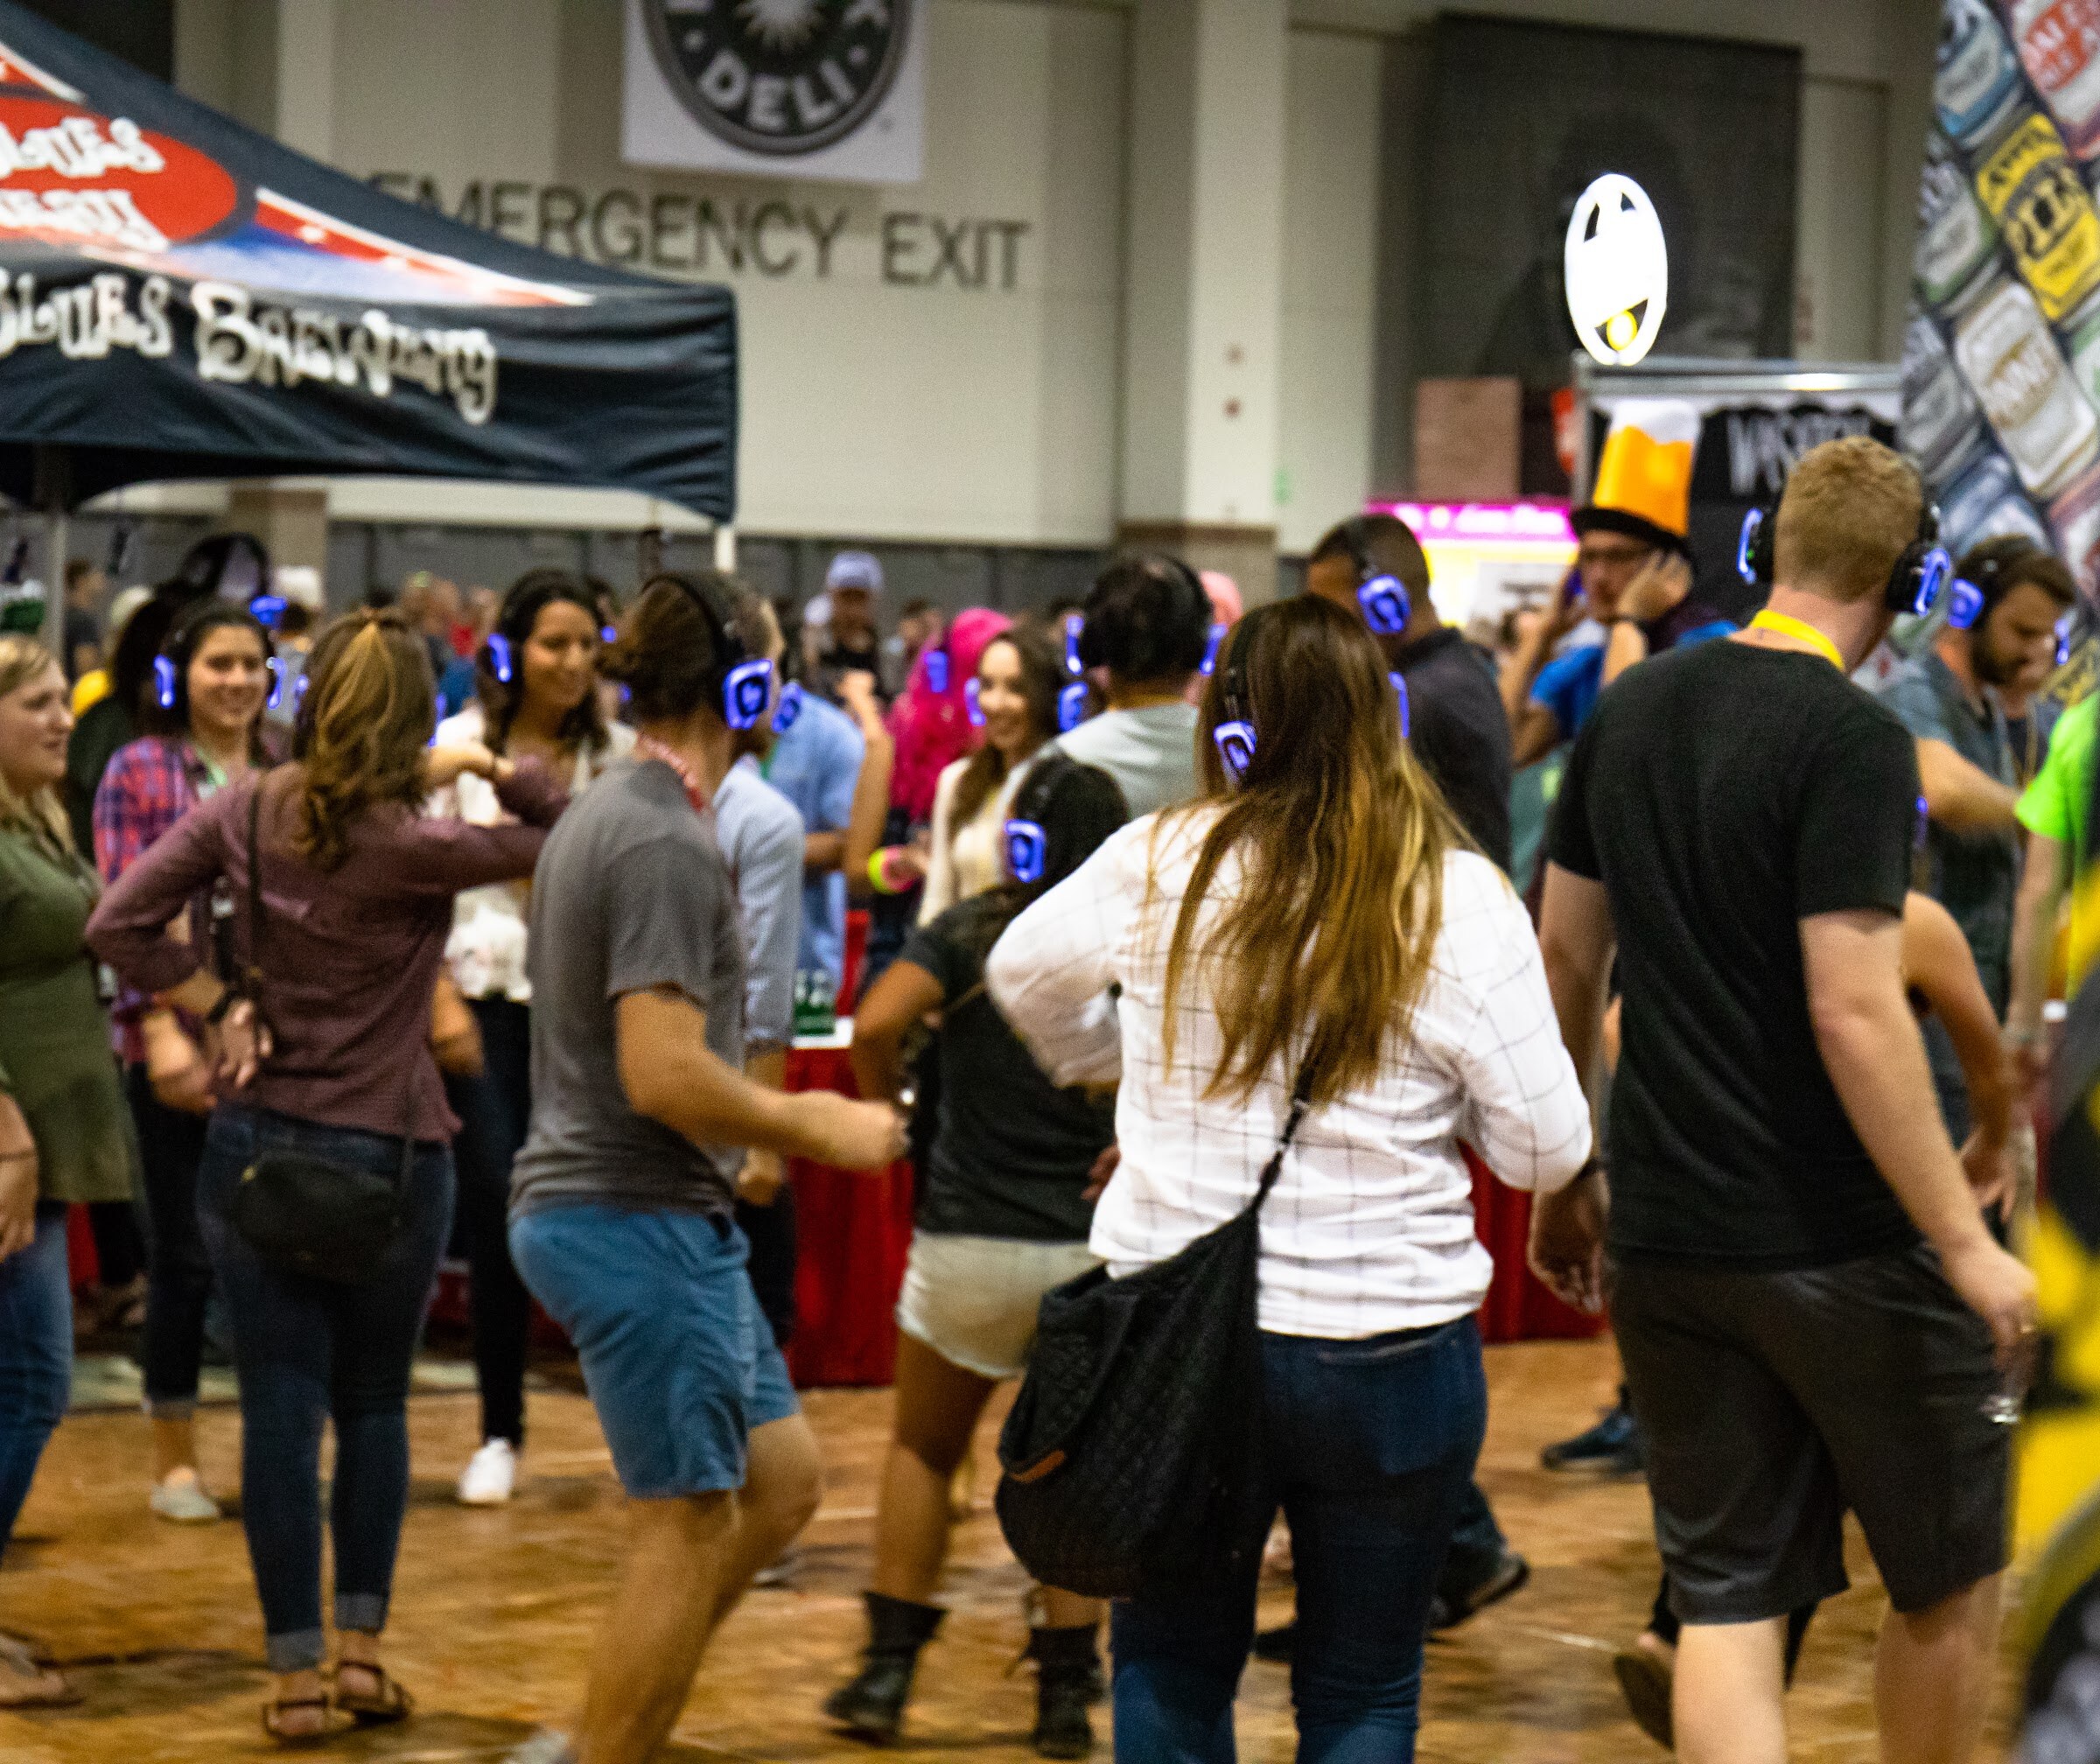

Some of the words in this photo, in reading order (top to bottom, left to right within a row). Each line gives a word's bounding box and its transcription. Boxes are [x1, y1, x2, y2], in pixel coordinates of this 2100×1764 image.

[702, 48, 857, 131] DELI
[0, 116, 166, 180] LUES
[370, 172, 851, 277] MERGENCY
[881, 212, 1032, 290] EXIT
